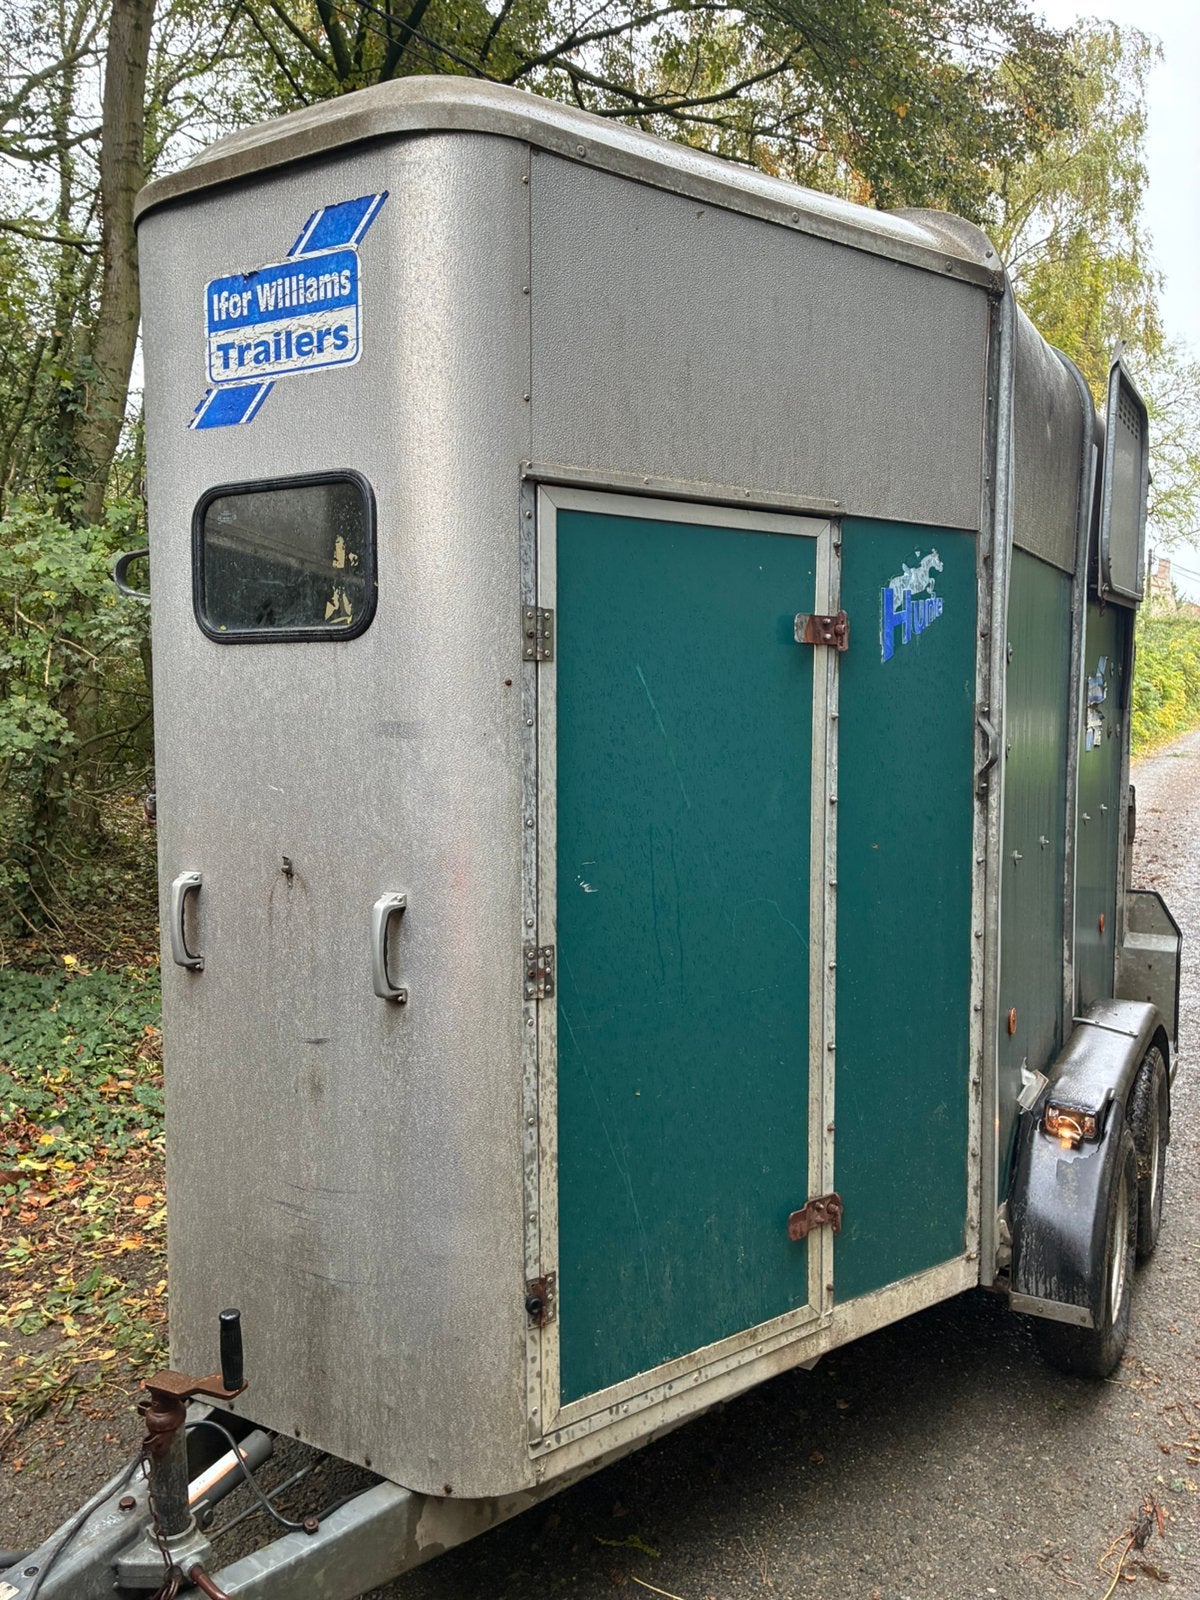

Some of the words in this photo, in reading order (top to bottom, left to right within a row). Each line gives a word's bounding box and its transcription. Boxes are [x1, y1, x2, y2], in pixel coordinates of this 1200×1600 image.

[213, 290, 252, 321] Ifor
[257, 271, 351, 312] Williams
[216, 325, 349, 369] Trailers
